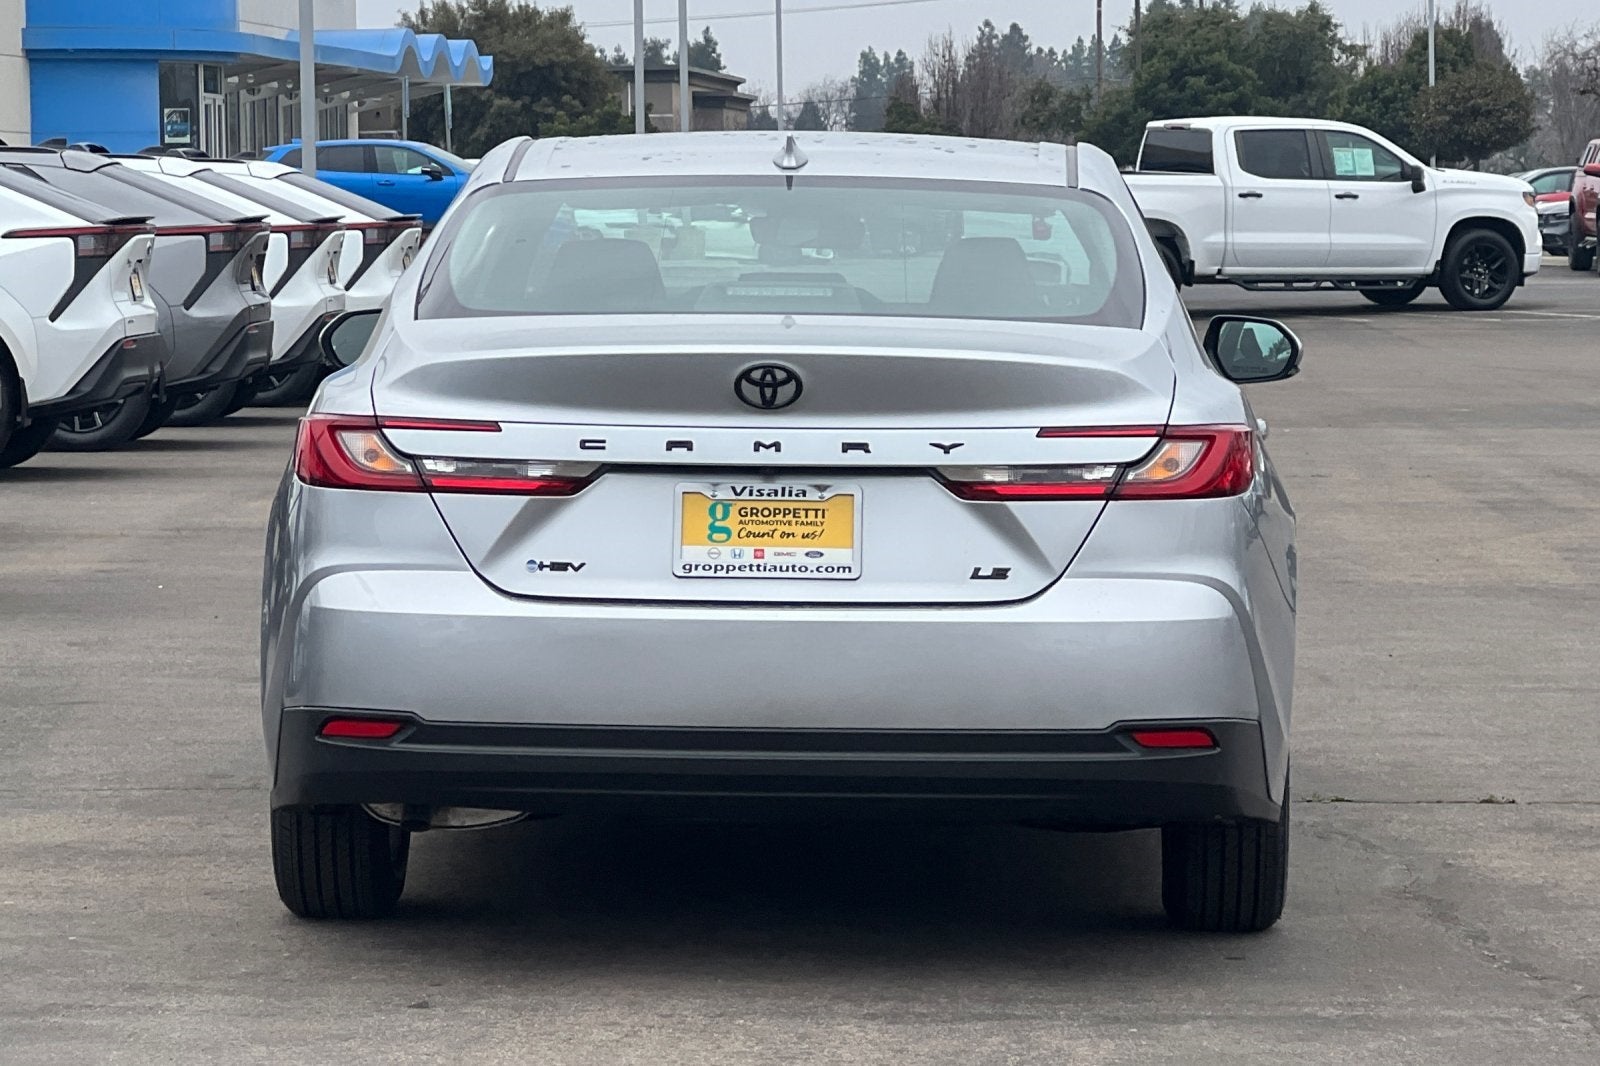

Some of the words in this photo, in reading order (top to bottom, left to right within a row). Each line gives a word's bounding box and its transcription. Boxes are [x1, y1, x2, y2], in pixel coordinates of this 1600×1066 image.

[579, 439, 965, 454] CAMRY
[730, 485, 808, 498] Visalia
[738, 506, 826, 519] GROPPETTI
[737, 527, 778, 539] Count
[801, 529, 825, 540] us!
[682, 562, 852, 575] groppettiauto.com
[969, 566, 1012, 580] LE
